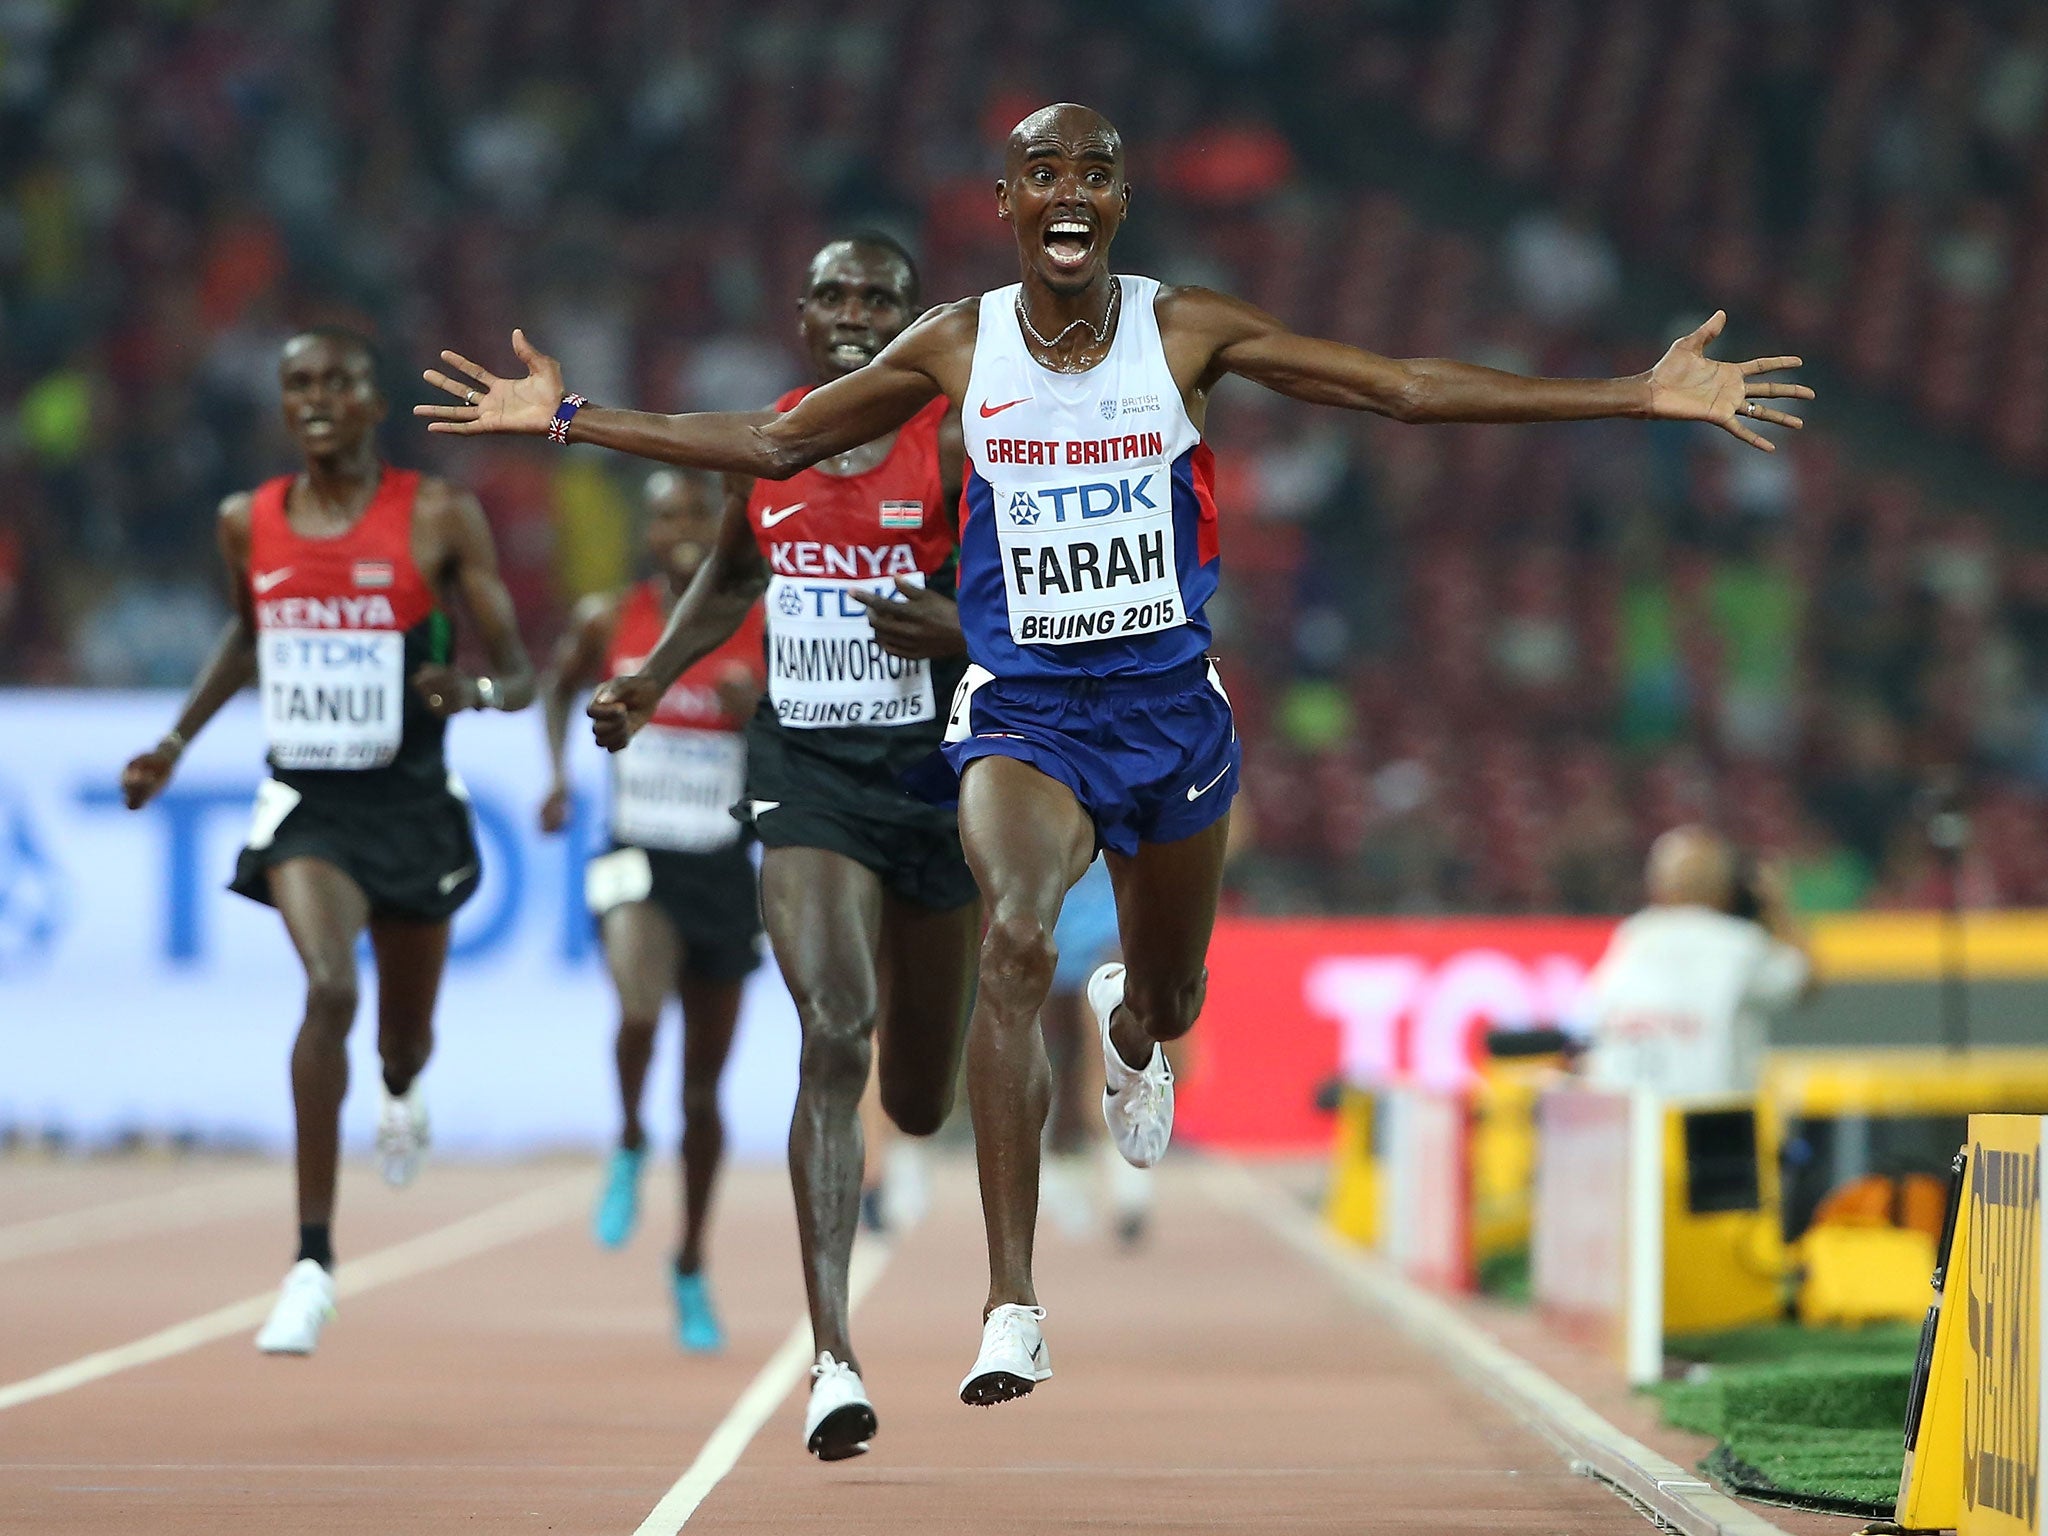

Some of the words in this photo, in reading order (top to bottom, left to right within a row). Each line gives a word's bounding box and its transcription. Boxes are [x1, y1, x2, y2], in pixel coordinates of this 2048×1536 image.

[1121, 394, 1159, 407] BRITISH
[1122, 403, 1161, 415] ATHLETICS
[986, 438, 1057, 465] GREAT
[1065, 431, 1163, 465] BRITAIN
[1037, 473, 1158, 523] TDK
[770, 541, 918, 577] KENYA
[1010, 529, 1166, 596] FARAH
[258, 595, 396, 629] KENYA
[1021, 609, 1115, 640] BEIJING
[1121, 598, 1174, 630] 2015
[294, 638, 383, 665] TDK
[272, 682, 385, 722] TANUI
[778, 699, 862, 722] BEIJING
[870, 694, 922, 721] 2015
[1962, 1141, 2041, 1531] SEIKO
